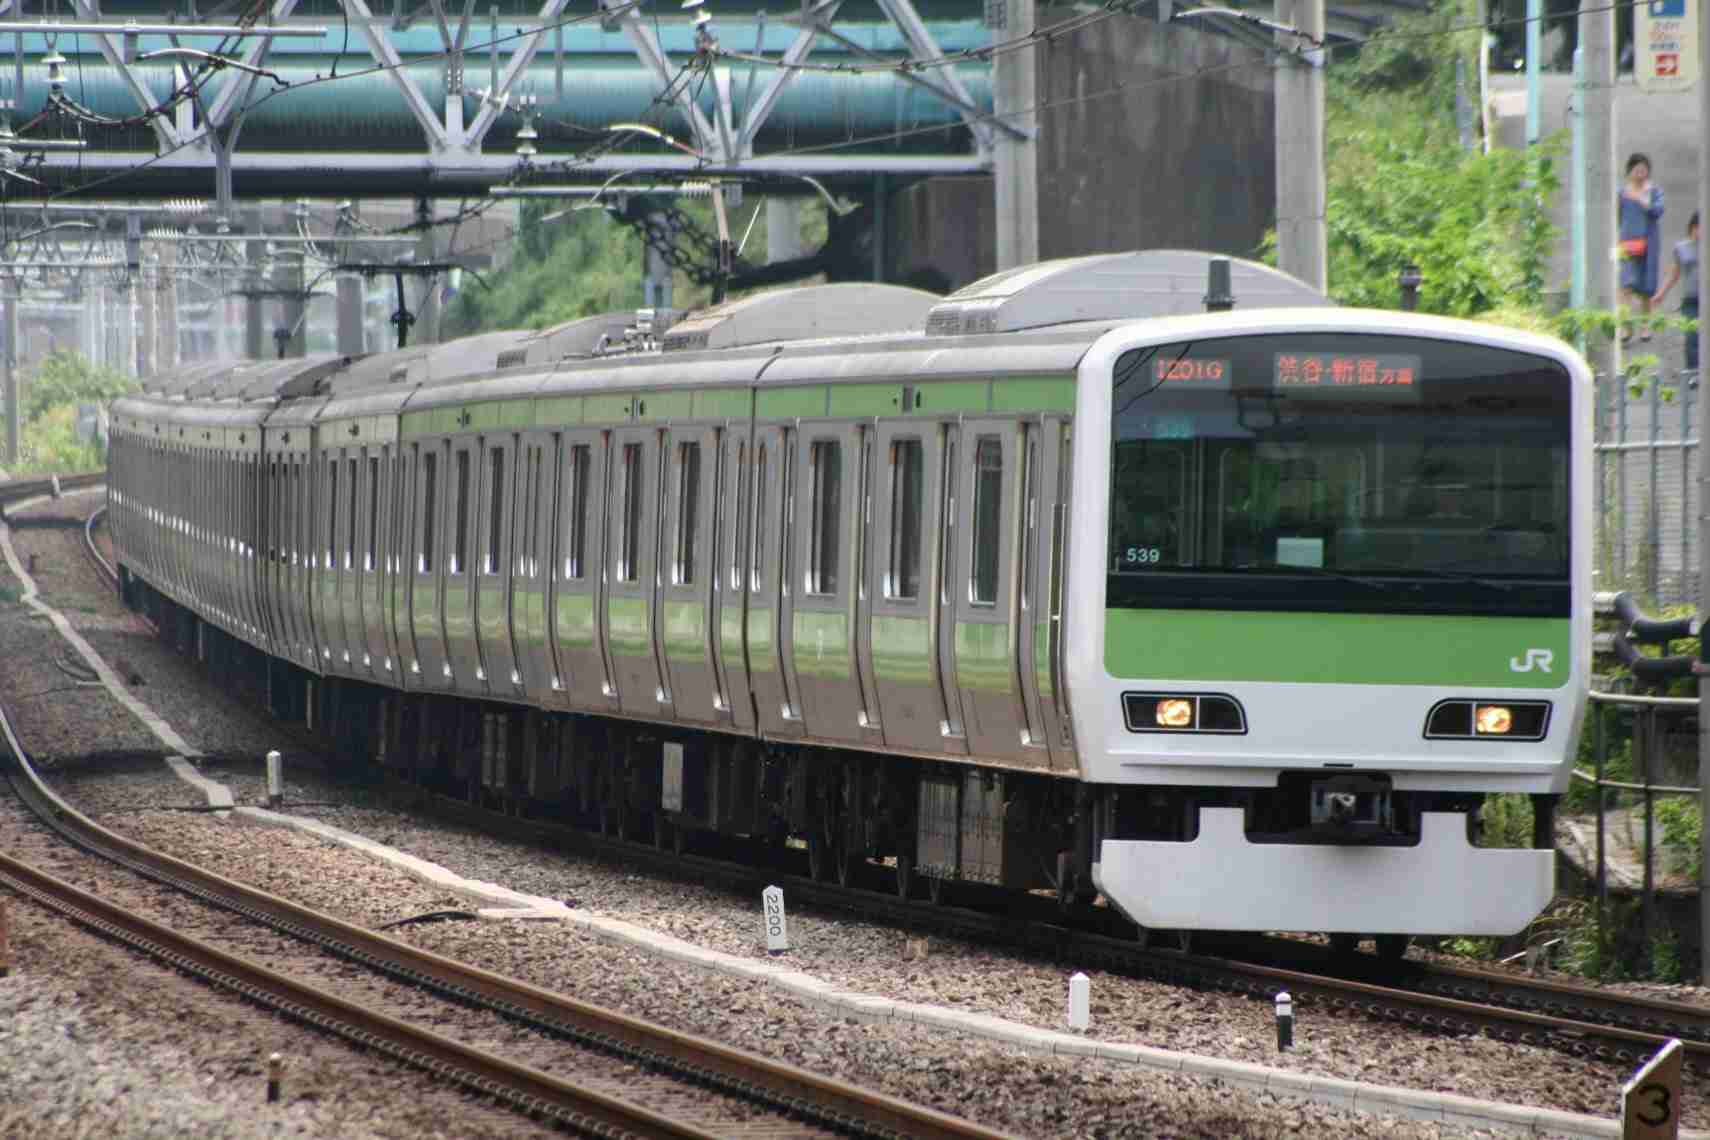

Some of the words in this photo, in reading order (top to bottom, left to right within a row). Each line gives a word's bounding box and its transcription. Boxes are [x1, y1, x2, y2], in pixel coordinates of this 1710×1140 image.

[1127, 547, 1160, 563] 539
[1510, 648, 1553, 673] JR
[767, 894, 781, 936] 2200
[1636, 1084, 1671, 1127] 3
